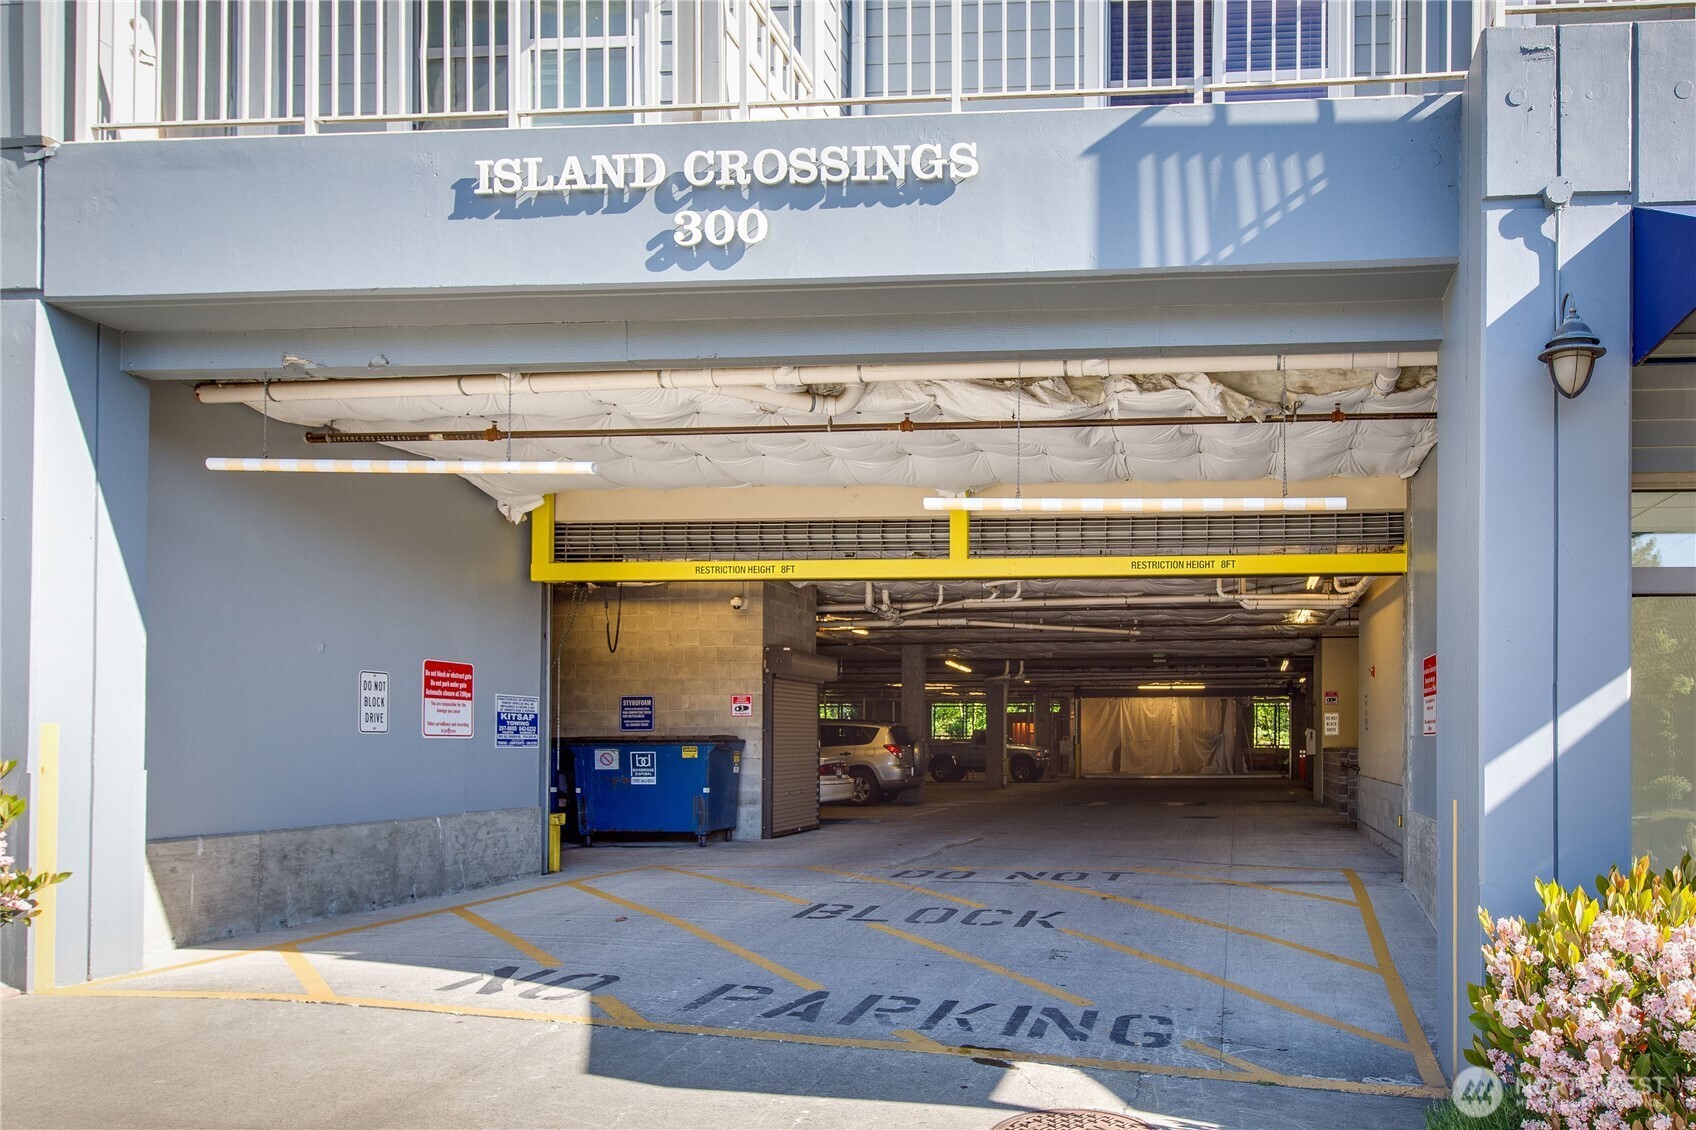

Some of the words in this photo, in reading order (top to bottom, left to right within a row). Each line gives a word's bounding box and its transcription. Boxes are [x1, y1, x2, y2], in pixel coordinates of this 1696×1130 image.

[474, 153, 666, 195] ISLAND
[683, 143, 979, 187] CROSSINGS
[674, 209, 768, 248] 300
[695, 565, 746, 574] RESTRICTION
[748, 565, 776, 574] HEIGHT
[780, 565, 796, 574] 8FT
[1131, 560, 1184, 570] RESTRICTION
[1186, 560, 1215, 569] HEIGHT
[1220, 560, 1236, 568] 8FT
[363, 680, 372, 691] DO
[374, 680, 386, 692] NOT
[364, 696, 385, 708] BLOCK
[365, 712, 384, 723] DRIVE
[500, 713, 535, 721] KITSAP
[889, 869, 978, 880] DO
[1004, 871, 1135, 882] NOT
[790, 902, 1066, 929] BLOCK
[434, 965, 620, 1001] NO
[681, 983, 1174, 1049] PARKING
